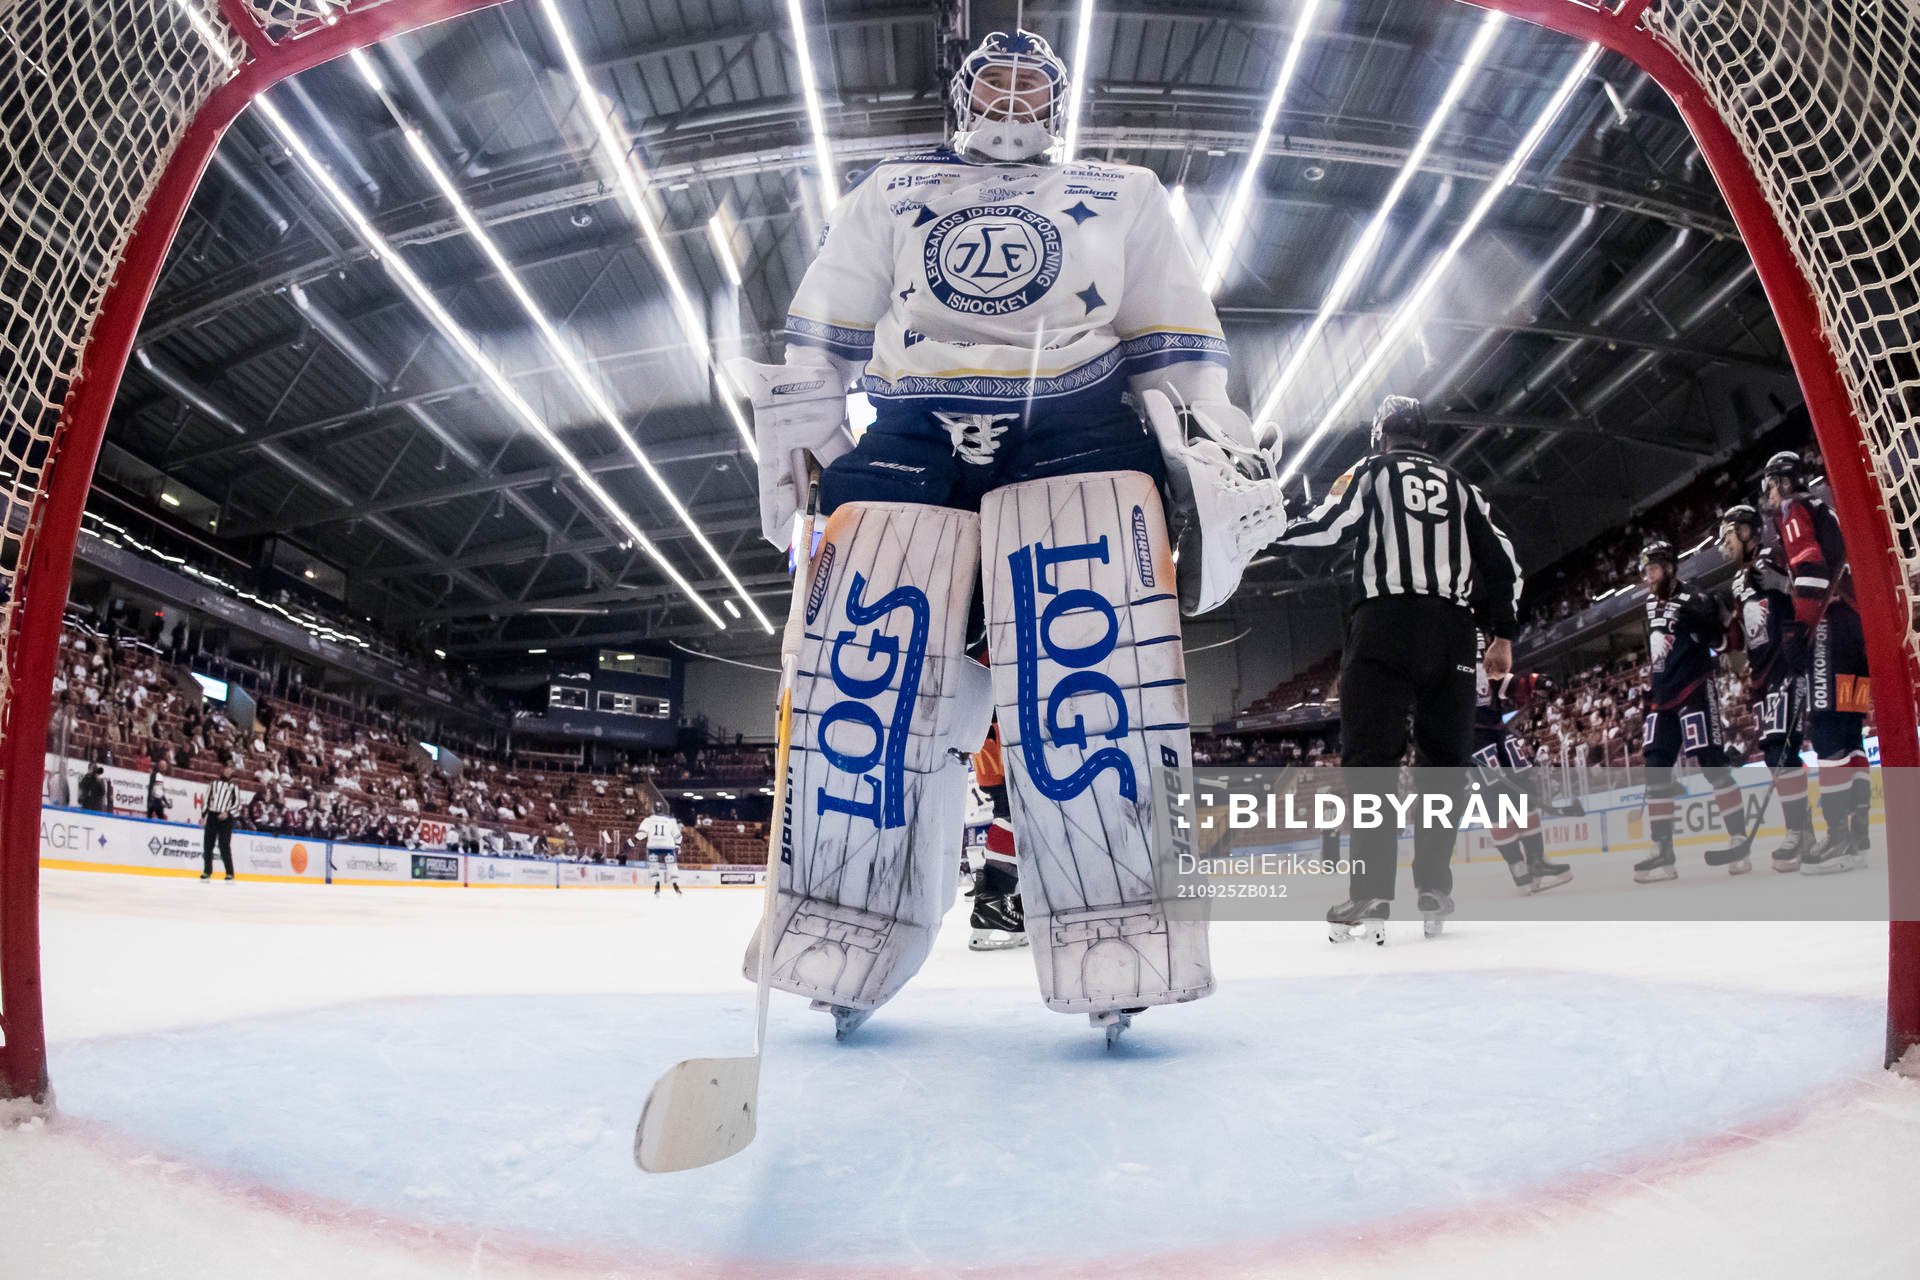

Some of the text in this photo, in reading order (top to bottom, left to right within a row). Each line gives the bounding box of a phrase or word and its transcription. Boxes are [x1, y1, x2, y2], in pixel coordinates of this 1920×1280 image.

[926, 212, 966, 289] LEKSANDS
[946, 291, 1030, 315] ISHOCKEY
[1401, 474, 1449, 517] 62
[1784, 517, 1802, 544] 11
[653, 824, 665, 837] 11
[1574, 822, 1589, 841] AB
